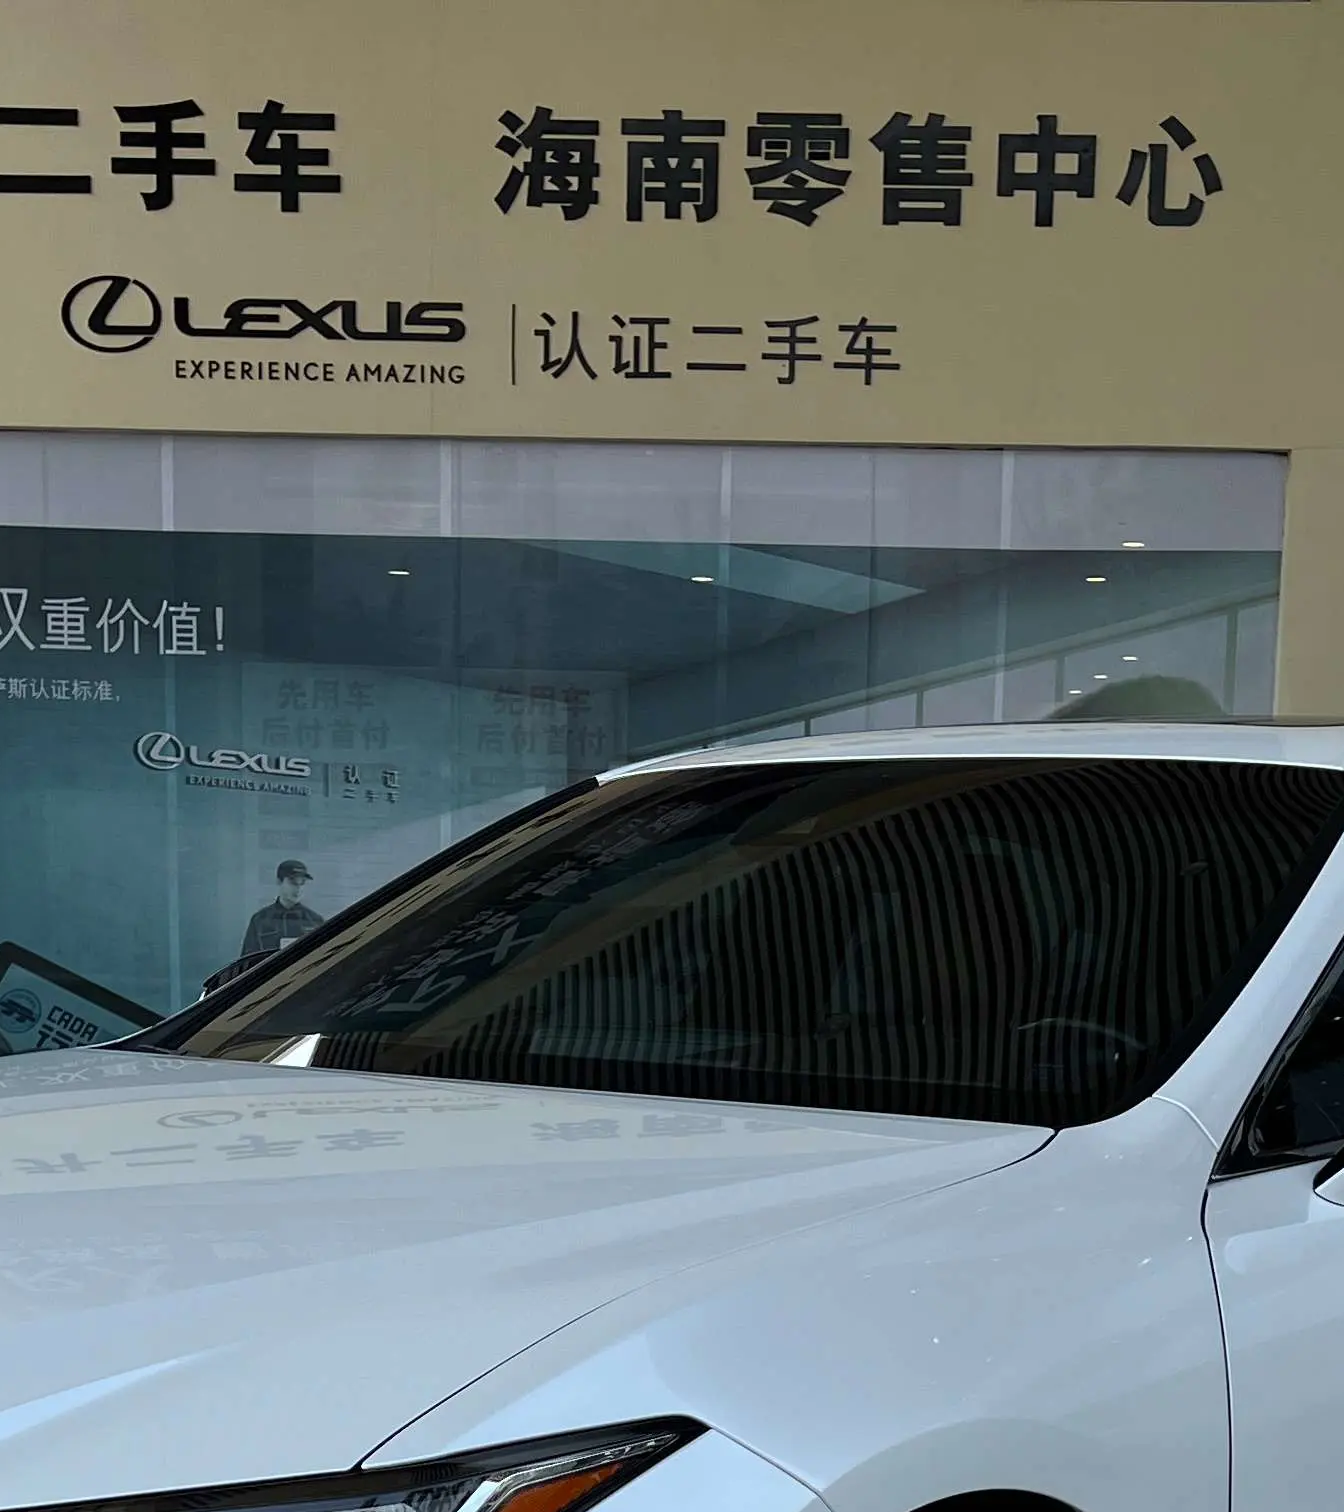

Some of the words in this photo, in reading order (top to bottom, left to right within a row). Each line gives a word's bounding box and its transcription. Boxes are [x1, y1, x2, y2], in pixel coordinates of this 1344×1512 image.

[495, 106, 1223, 228] 海南零售中心
[174, 297, 467, 343] LEXUS
[534, 311, 902, 386] 认证二手车
[175, 359, 336, 382] EXPERIENCE
[346, 364, 466, 386] AMAZING
[188, 744, 312, 777] LEXUS
